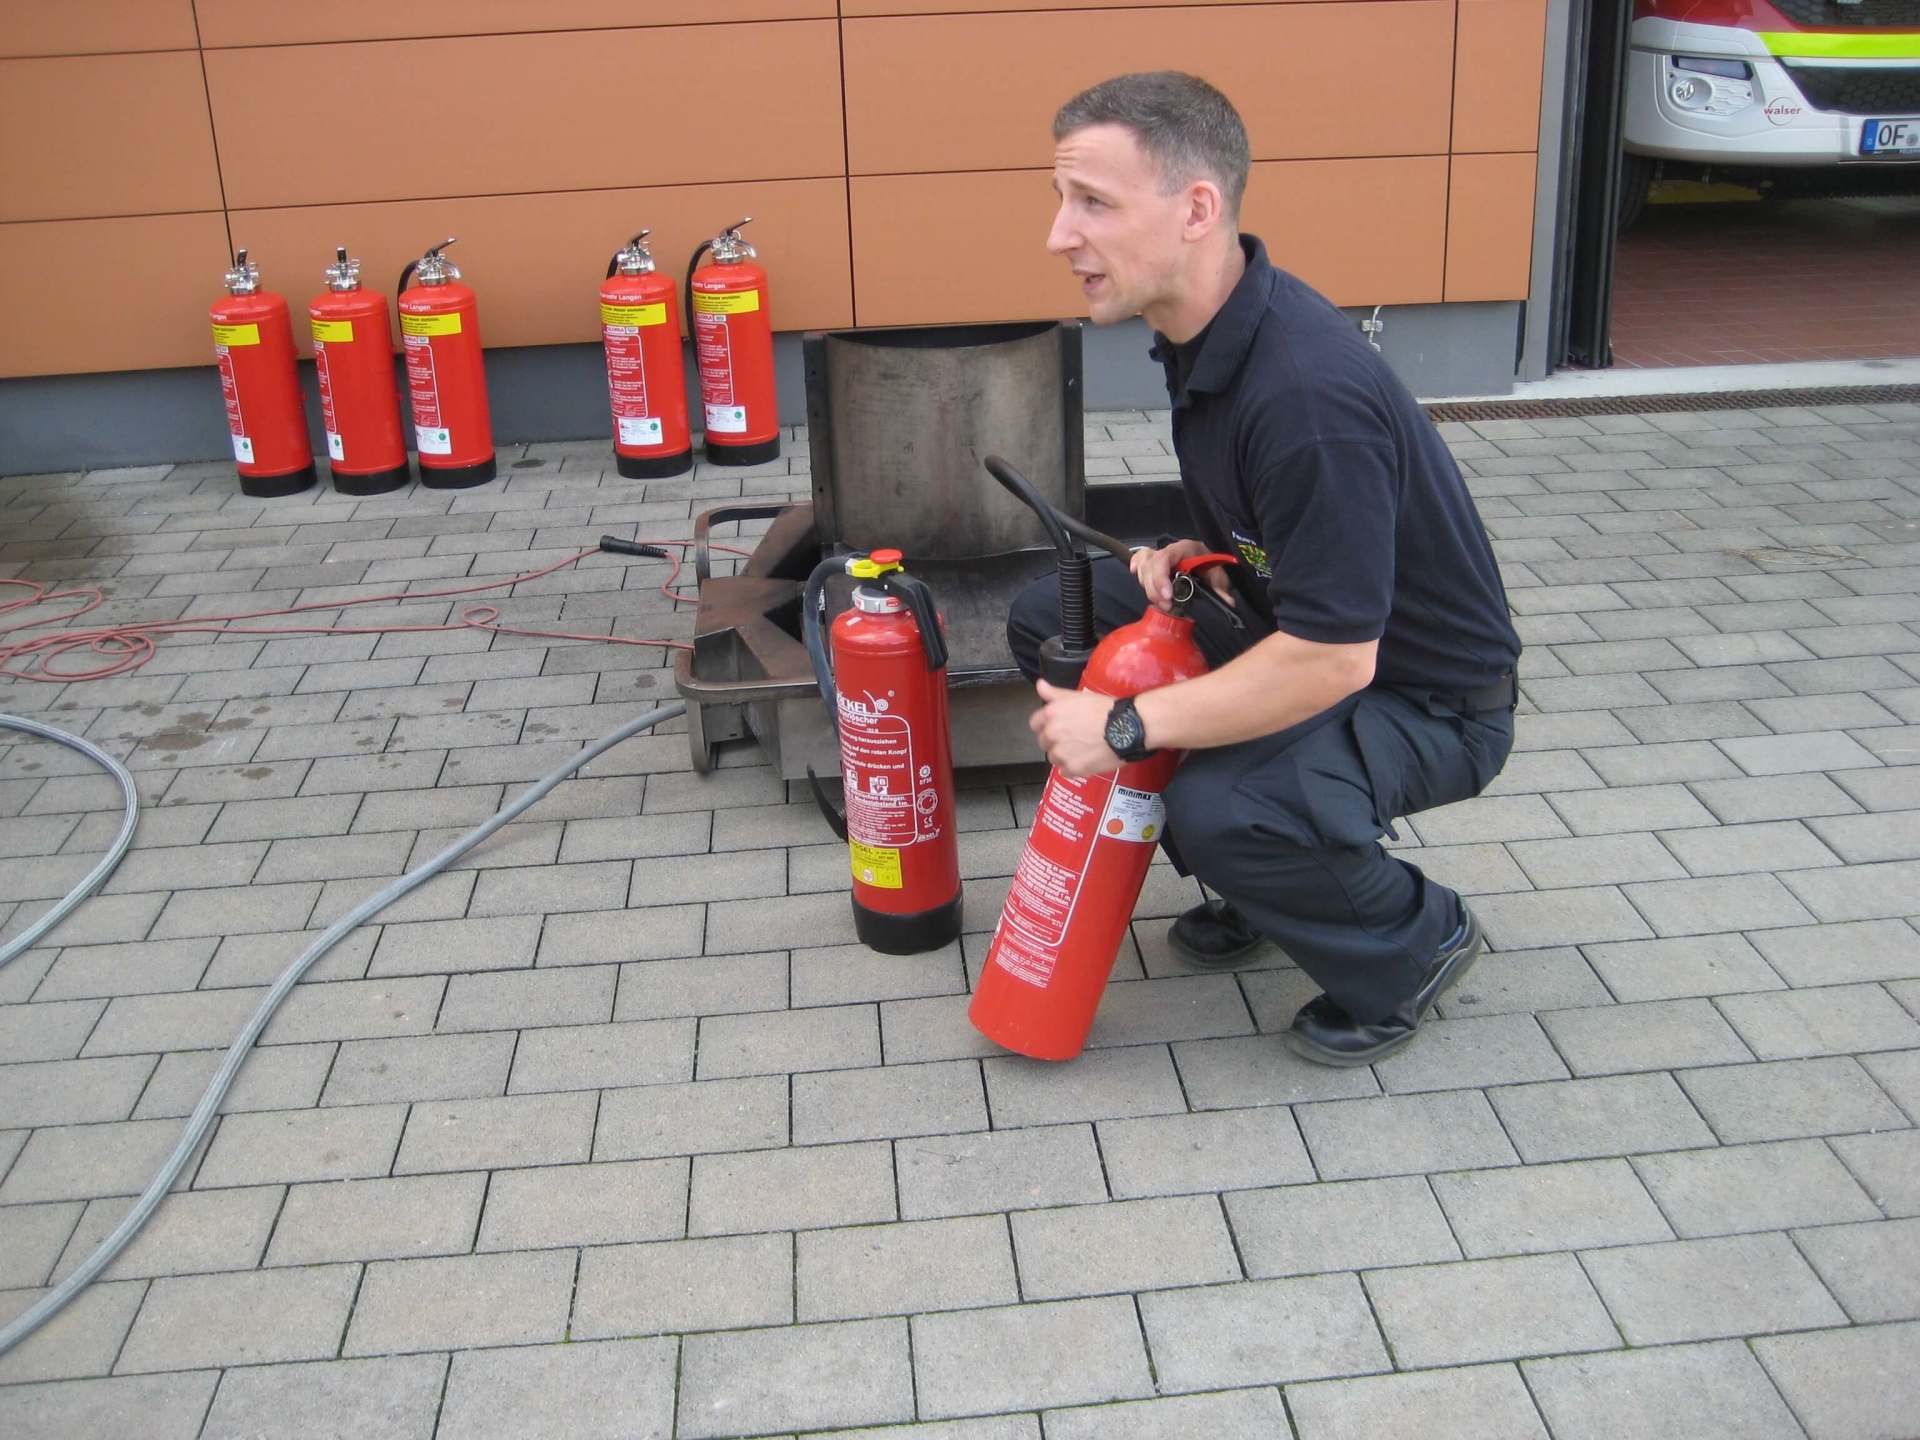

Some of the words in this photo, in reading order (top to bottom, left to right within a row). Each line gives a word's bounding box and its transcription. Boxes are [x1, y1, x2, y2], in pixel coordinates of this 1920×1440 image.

[1763, 105, 1801, 115] walser
[1878, 124, 1909, 147] OF
[1118, 788, 1151, 800] minimax
